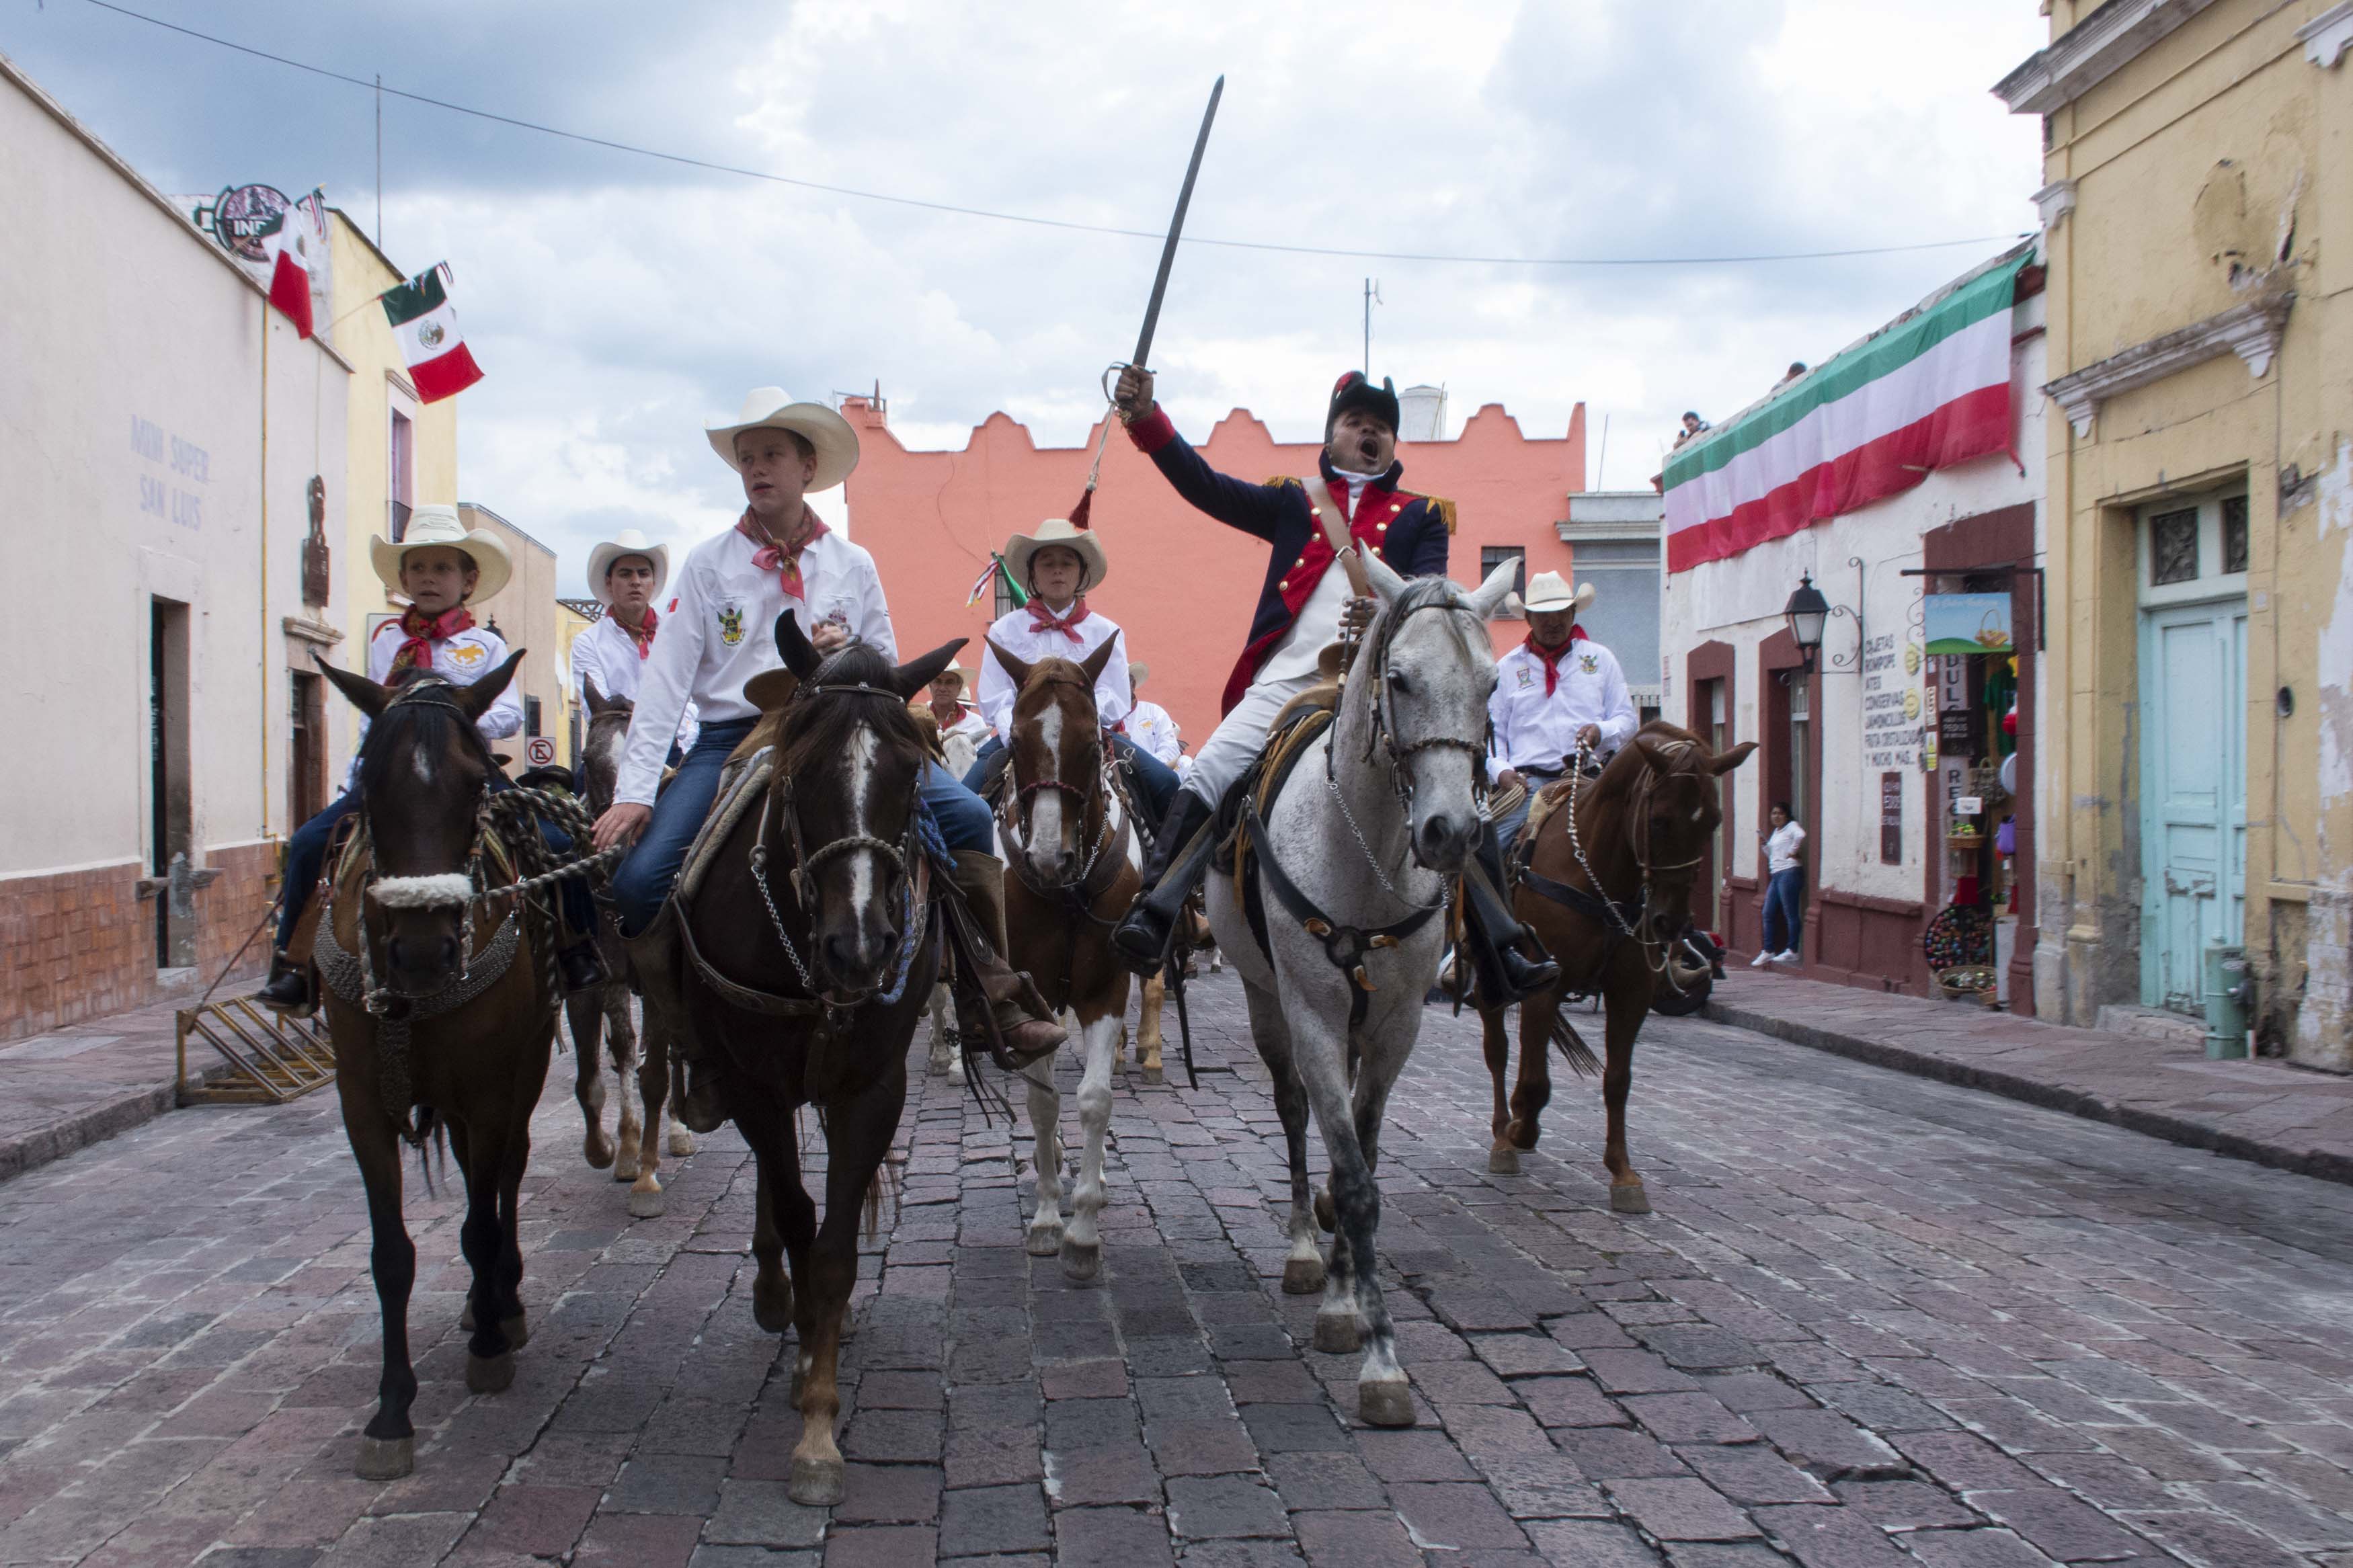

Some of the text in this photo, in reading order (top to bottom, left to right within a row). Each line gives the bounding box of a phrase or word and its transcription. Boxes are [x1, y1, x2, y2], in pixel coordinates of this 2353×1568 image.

[171, 434, 210, 485] SUPER
[139, 472, 201, 531] SAN LUIS
